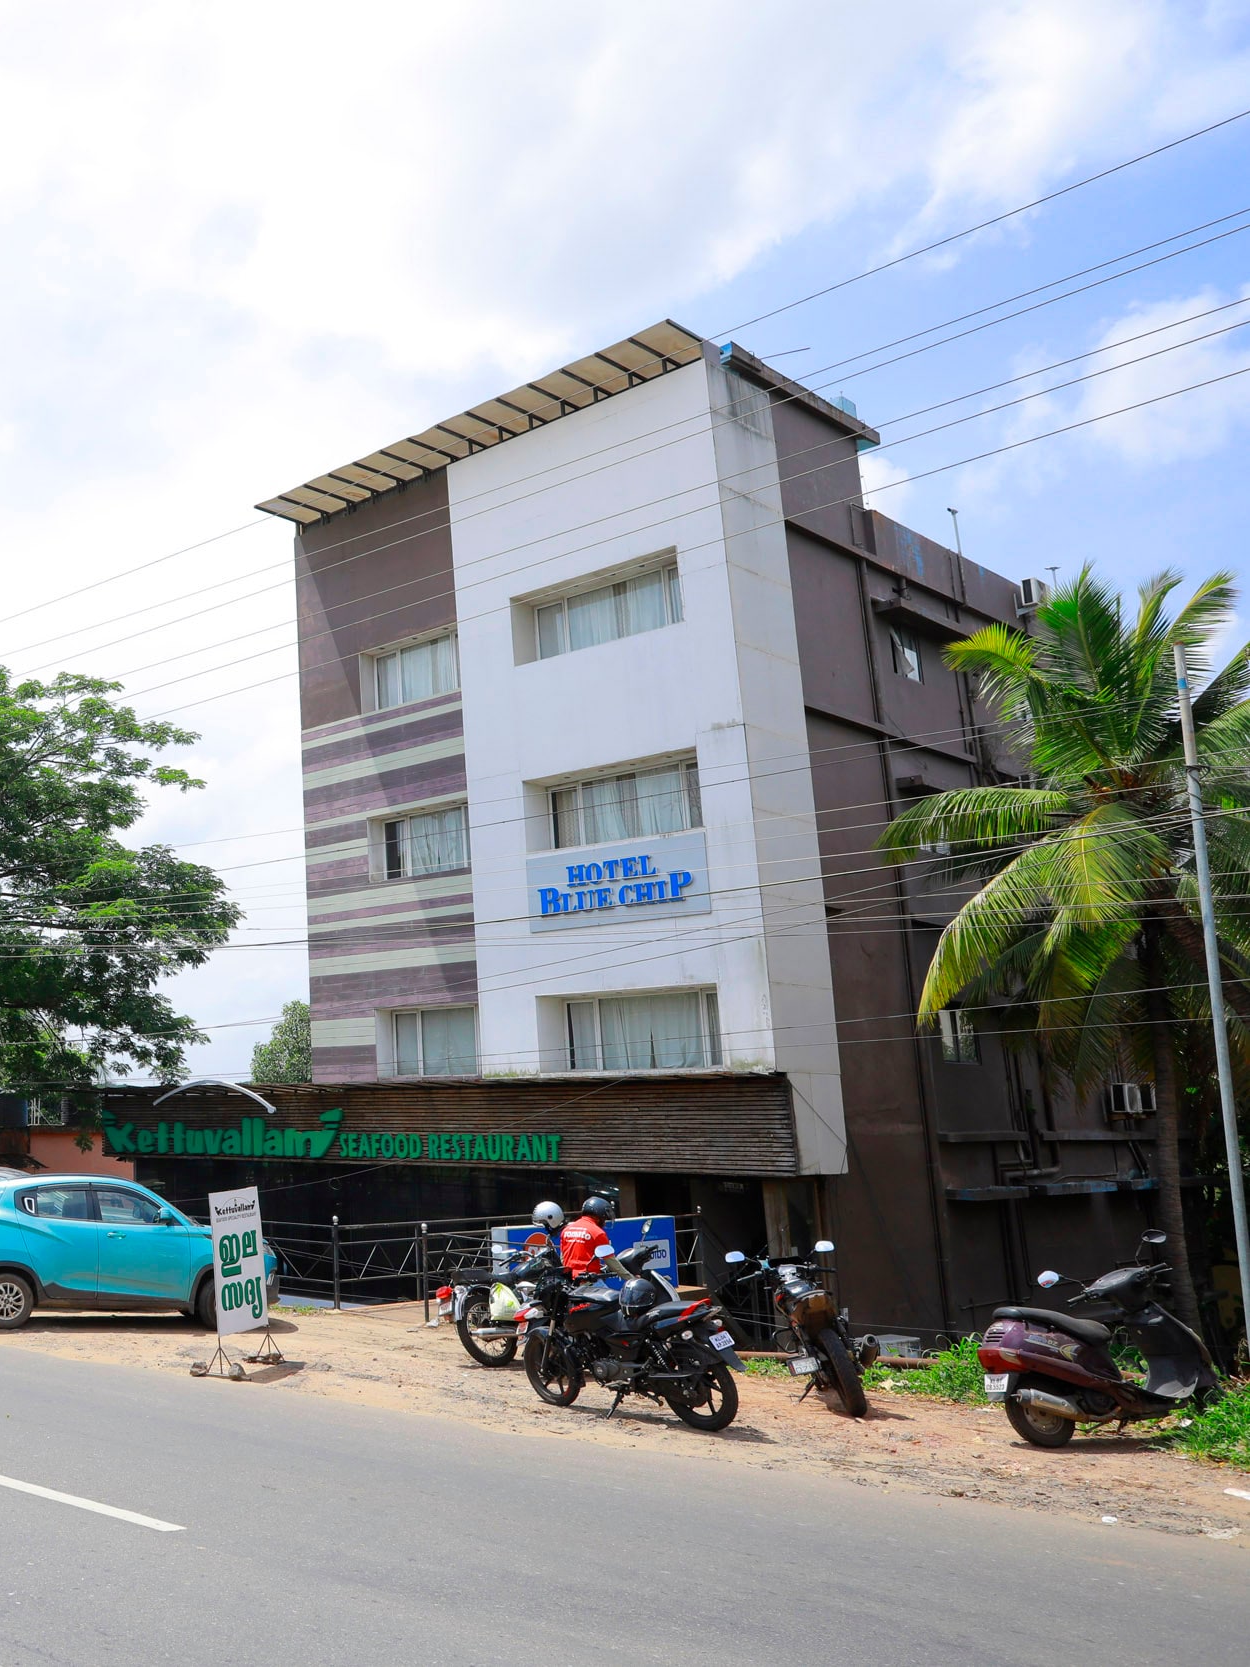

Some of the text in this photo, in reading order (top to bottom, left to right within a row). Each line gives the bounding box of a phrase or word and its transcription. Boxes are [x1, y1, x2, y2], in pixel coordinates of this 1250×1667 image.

[566, 855, 657, 887] HOTEL
[537, 870, 693, 917] BLUE CHIP
[338, 1132, 422, 1159] SEAFOOD
[427, 1133, 563, 1163] RESTAURANT
